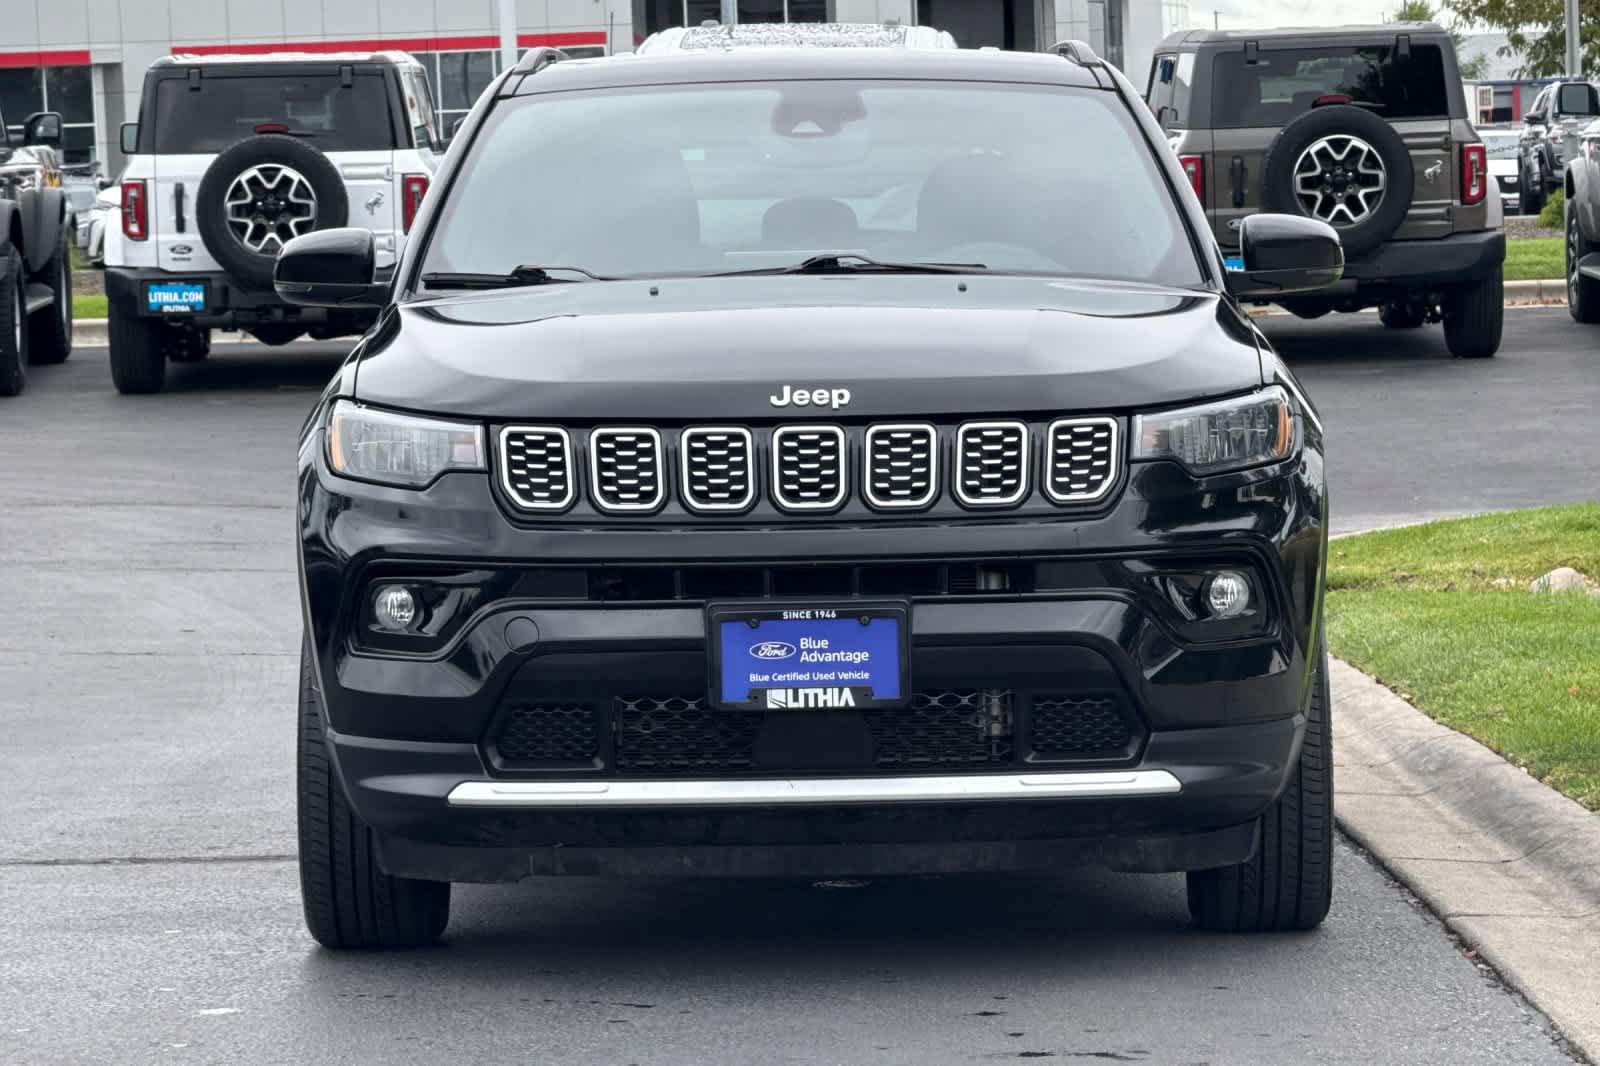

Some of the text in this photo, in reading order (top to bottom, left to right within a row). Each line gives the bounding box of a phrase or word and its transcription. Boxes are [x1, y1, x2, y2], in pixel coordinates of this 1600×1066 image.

[148, 291, 204, 303] LITHIA.COM
[770, 385, 850, 408] Jeep
[782, 609, 837, 620] SINCE 1946
[800, 637, 829, 649] Blue
[758, 643, 788, 657] Ford
[800, 650, 870, 664] Advantage
[749, 670, 870, 682] Blue Certified Used Vehicle
[786, 687, 856, 708] LITHIA
